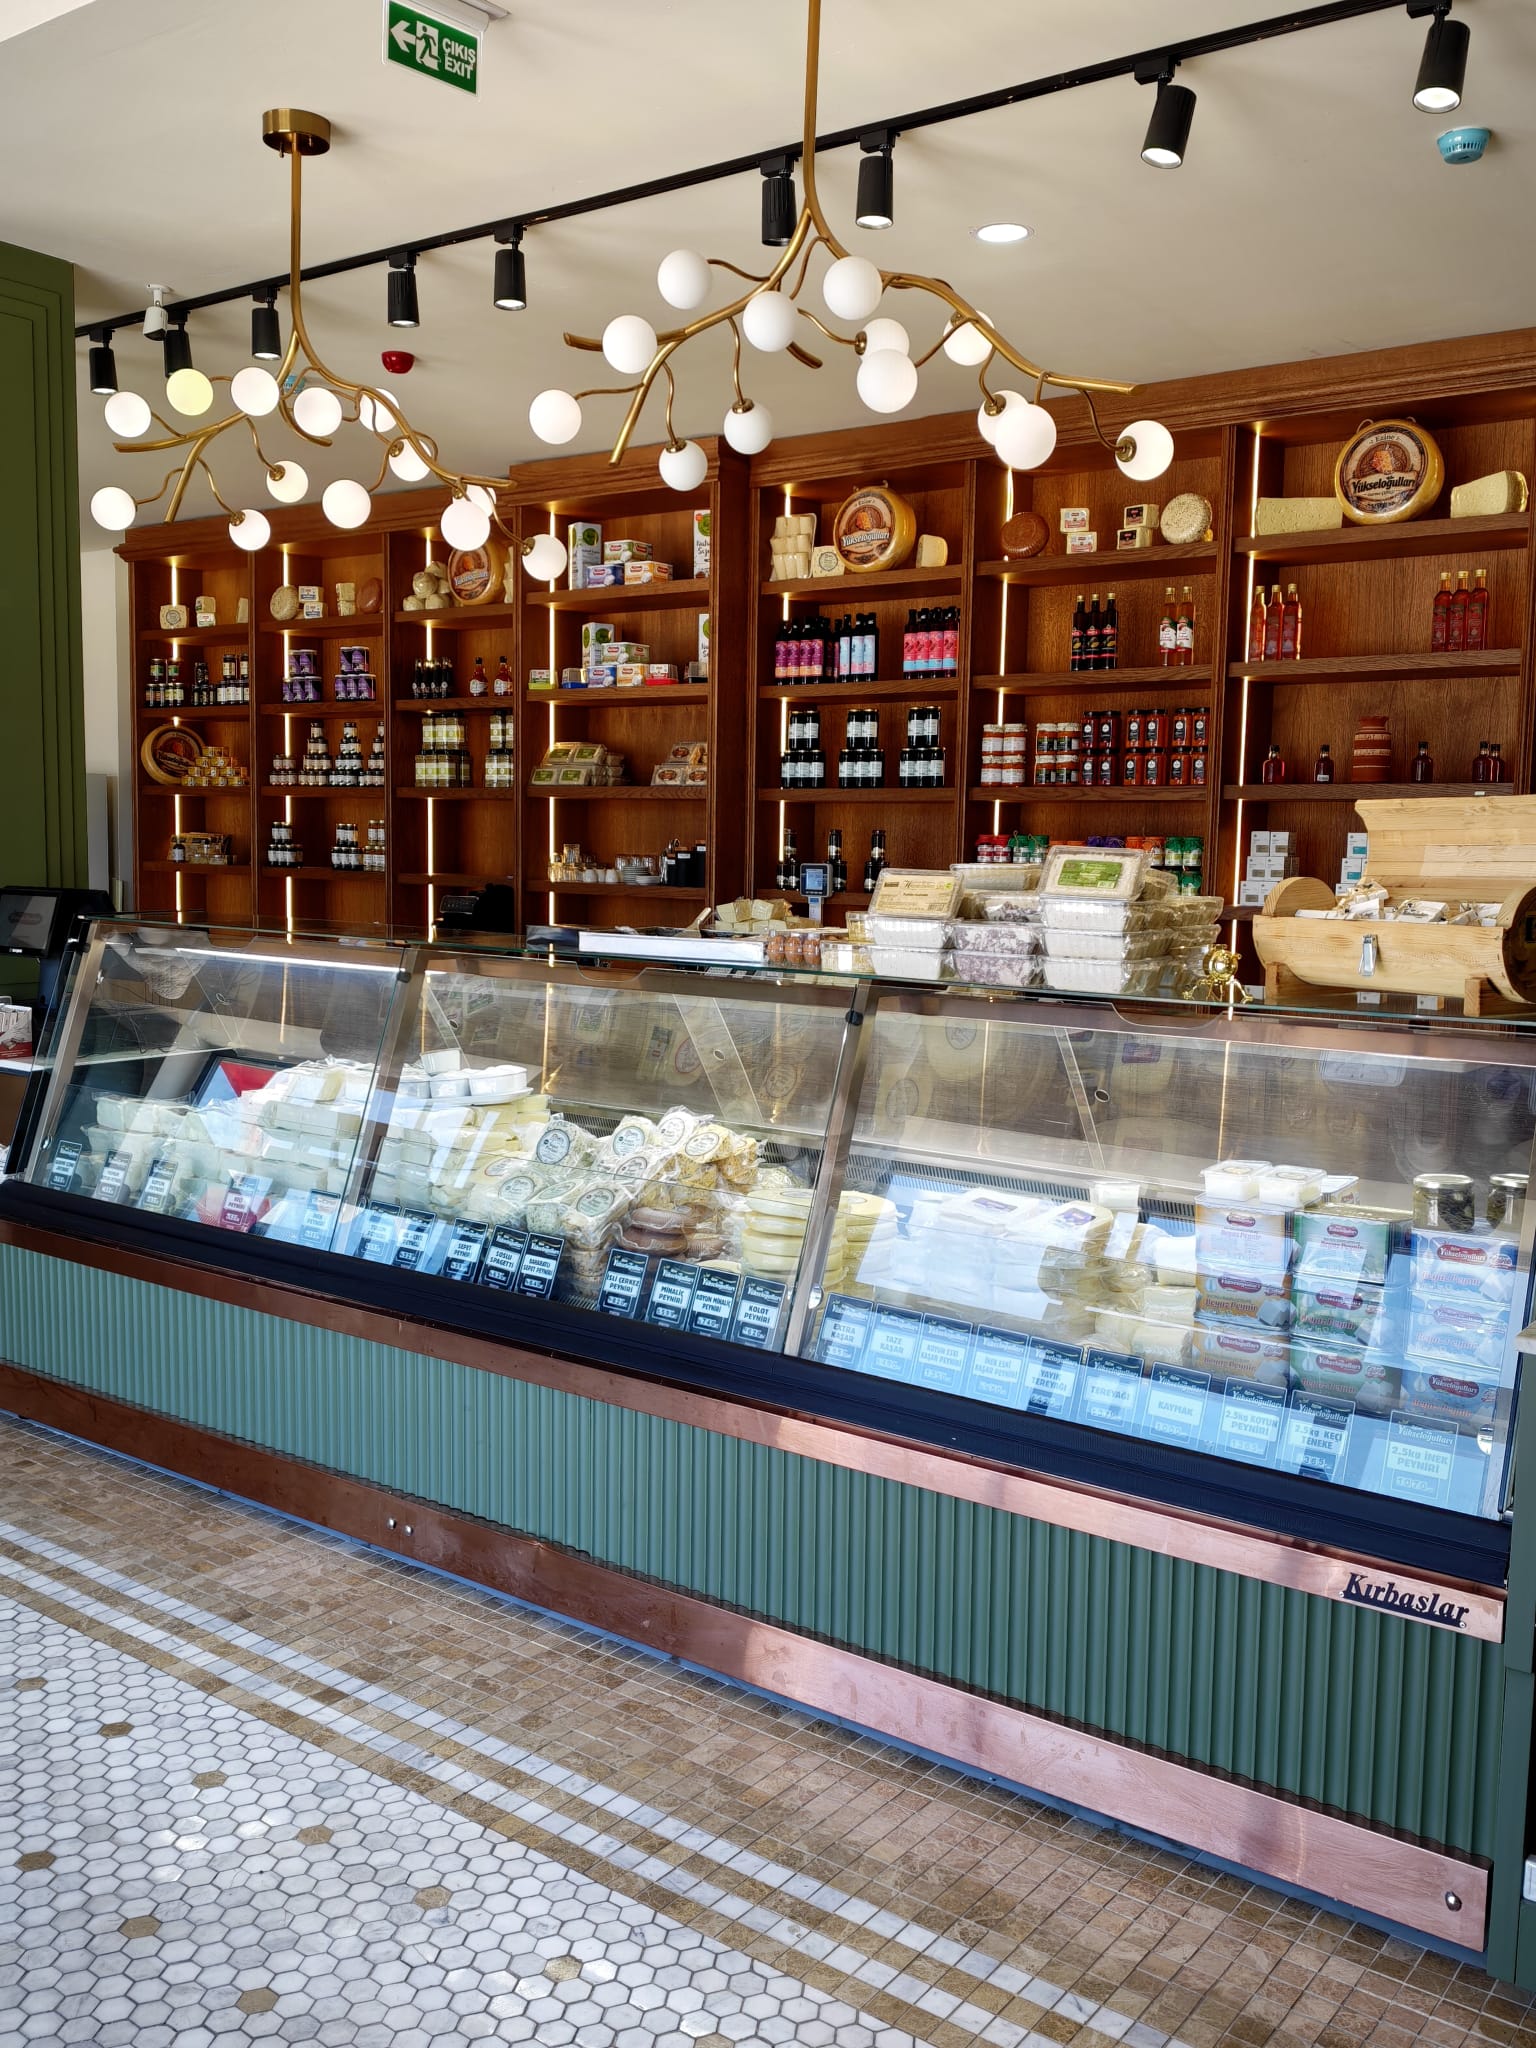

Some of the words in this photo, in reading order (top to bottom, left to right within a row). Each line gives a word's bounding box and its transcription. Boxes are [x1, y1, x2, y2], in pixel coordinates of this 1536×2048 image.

[444, 56, 474, 79] EXIT
[743, 1312, 770, 1324] PEYNİRİ
[833, 1323, 856, 1335] EXTRA
[1158, 1400, 1193, 1417] KAYMAK
[1301, 1435, 1333, 1449] TENEKE
